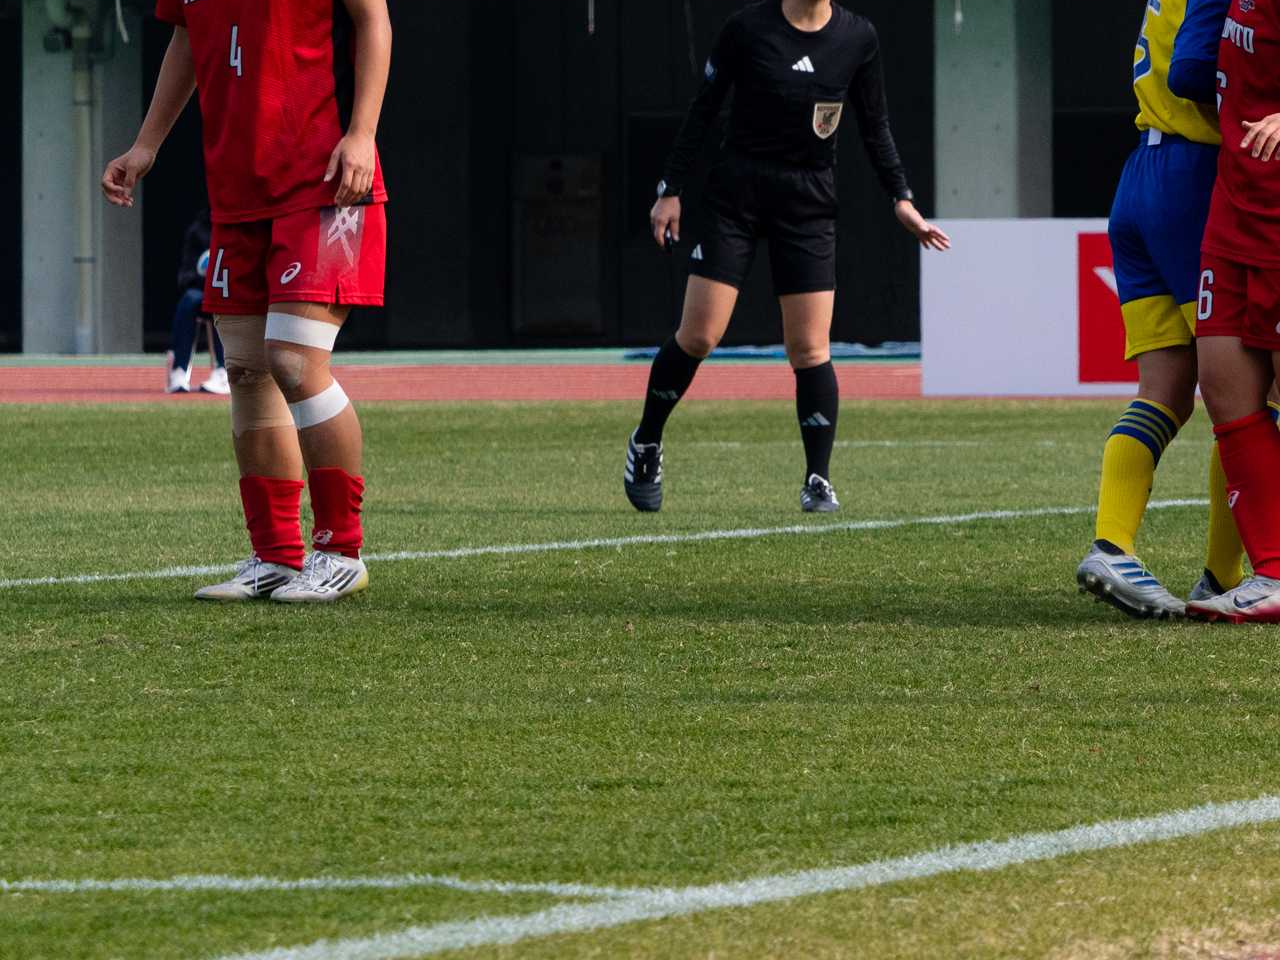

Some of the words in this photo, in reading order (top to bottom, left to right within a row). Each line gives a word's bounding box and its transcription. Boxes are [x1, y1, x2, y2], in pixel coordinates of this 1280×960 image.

[229, 25, 242, 77] 4
[212, 248, 229, 298] 4
[1197, 269, 1215, 321] 6
